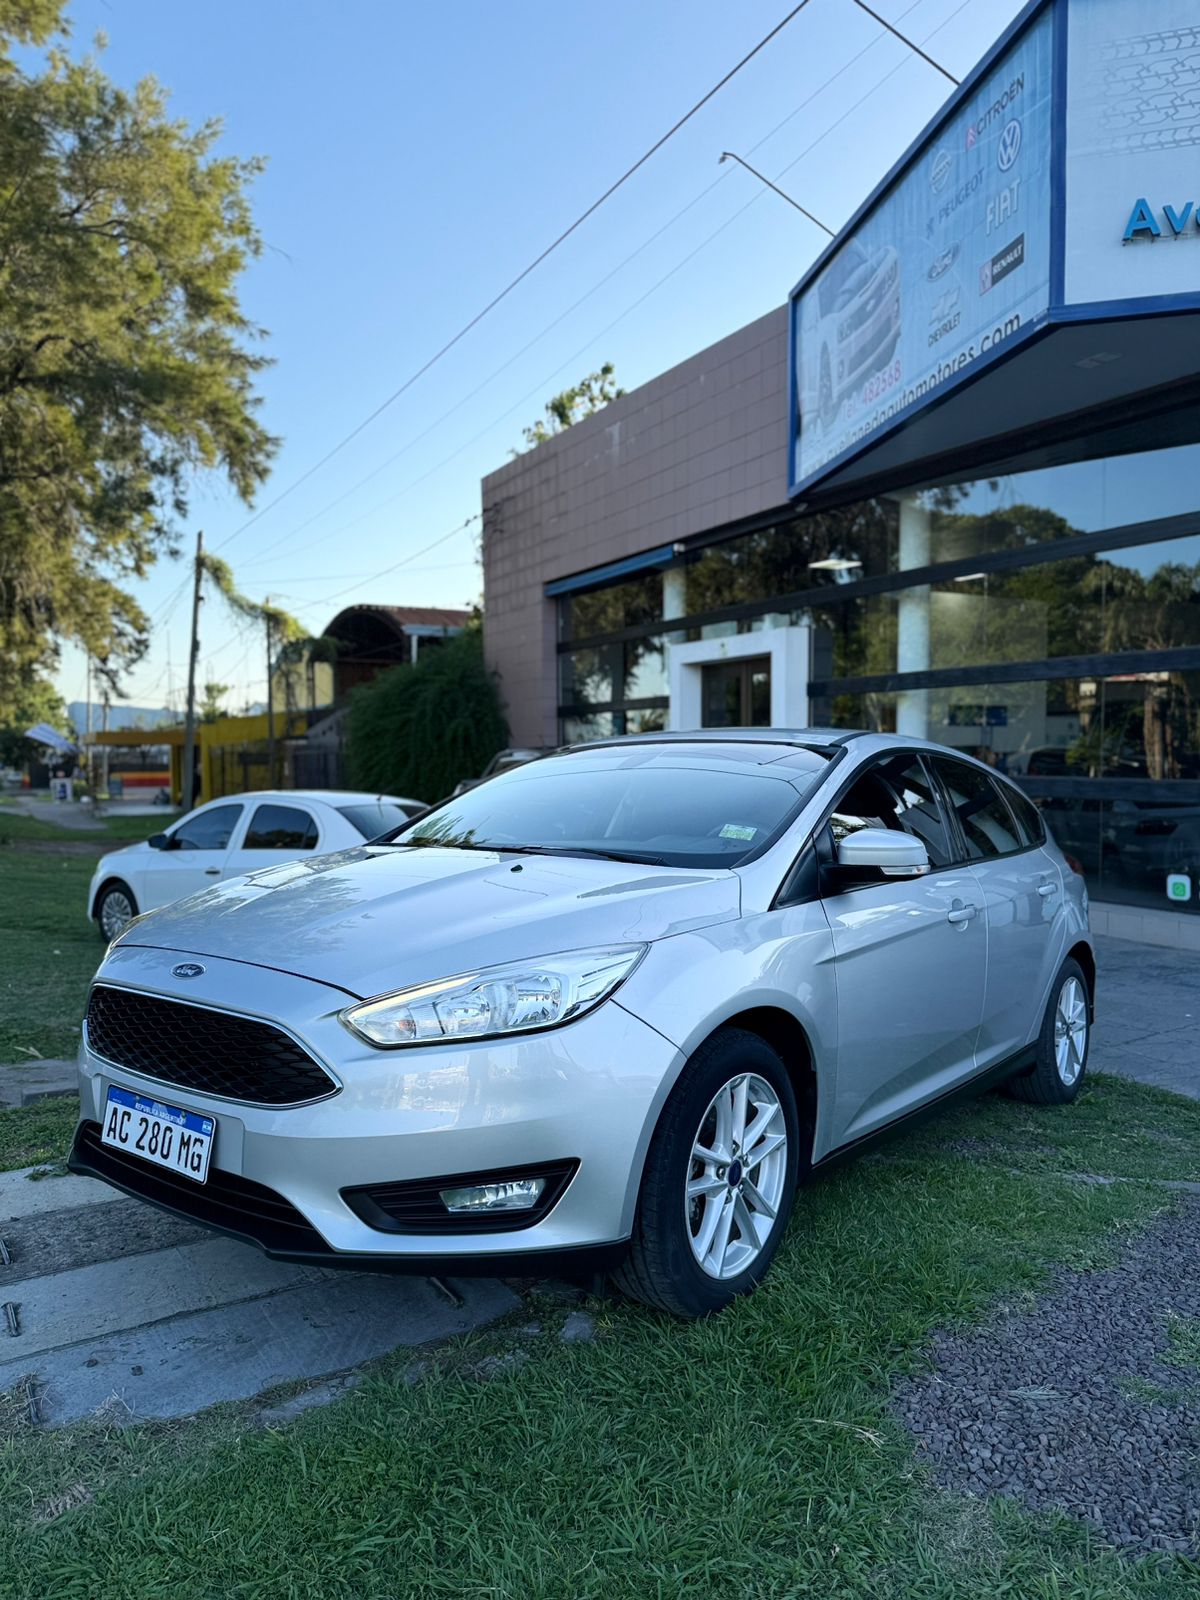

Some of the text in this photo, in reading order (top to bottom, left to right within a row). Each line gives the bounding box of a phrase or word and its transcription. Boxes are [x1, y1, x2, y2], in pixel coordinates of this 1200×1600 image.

[939, 168, 984, 224] PEUGEOT
[985, 178, 1021, 237] FIAT
[1122, 198, 1200, 241] Av
[992, 244, 1023, 276] RENAULT
[927, 311, 961, 348] CHEVROLET
[107, 1107, 204, 1173] AC 280 MG
